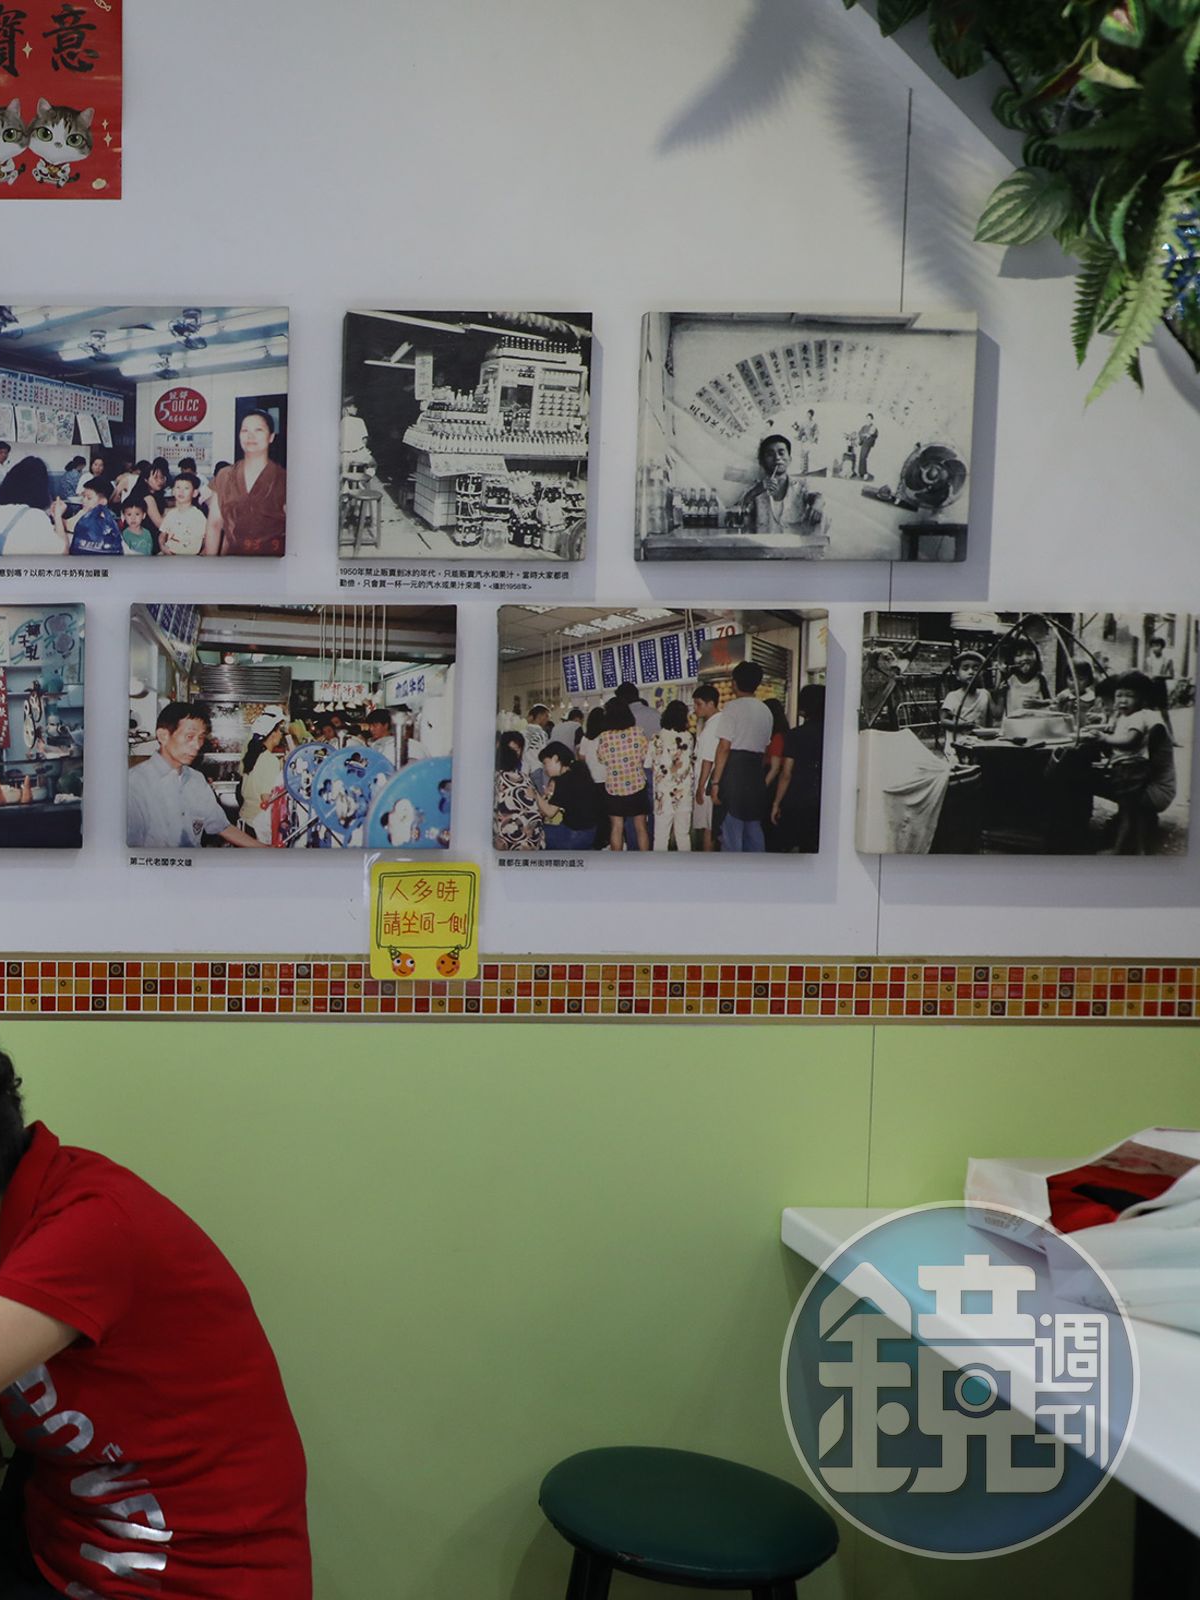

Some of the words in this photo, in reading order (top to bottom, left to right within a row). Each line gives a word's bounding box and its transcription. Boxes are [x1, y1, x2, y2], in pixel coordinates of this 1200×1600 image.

[42, 3, 100, 73] 意
[389, 878, 460, 903] 人多時
[383, 910, 468, 937] 請坐同一側
